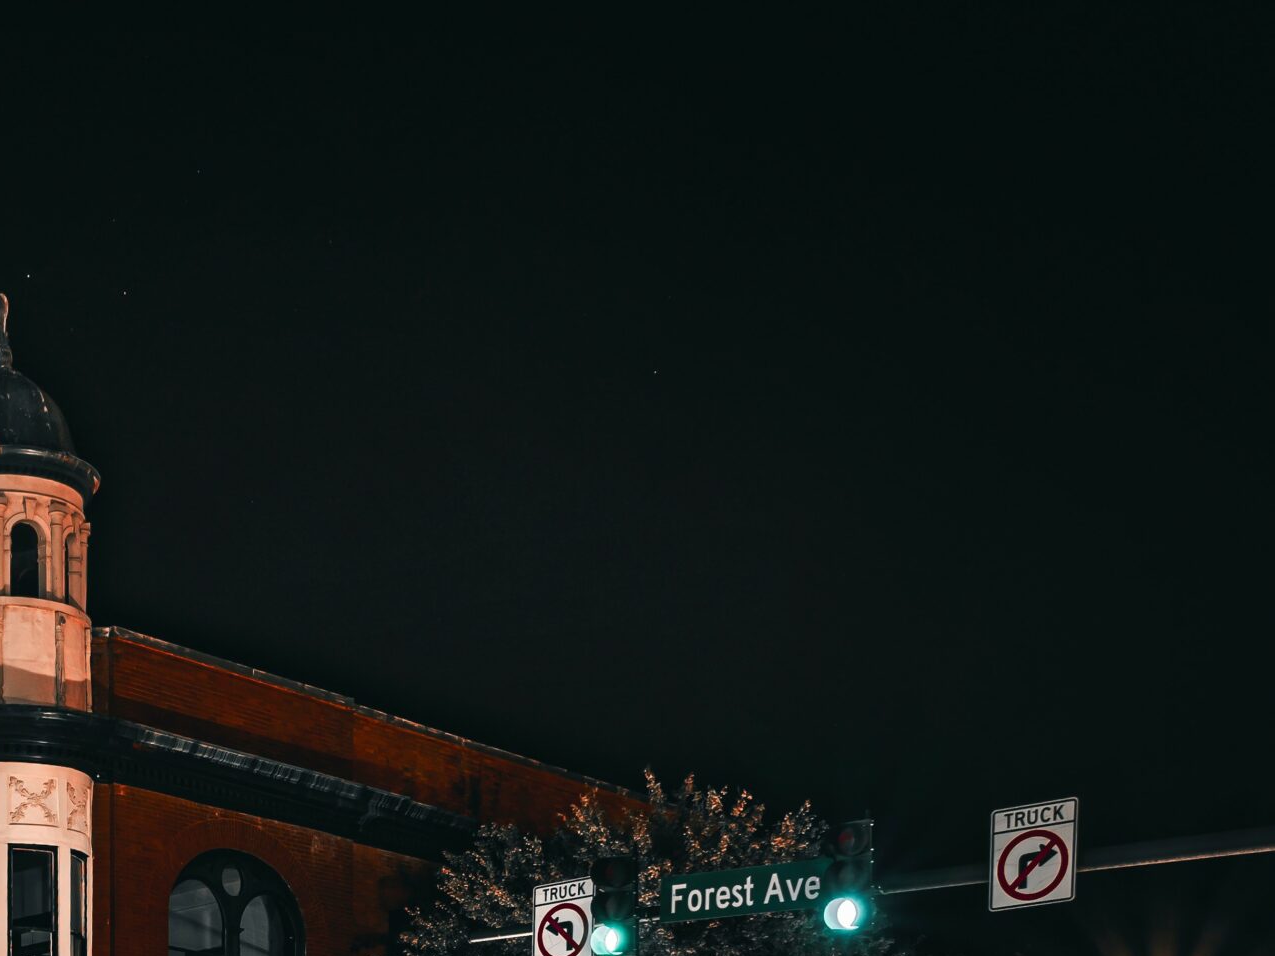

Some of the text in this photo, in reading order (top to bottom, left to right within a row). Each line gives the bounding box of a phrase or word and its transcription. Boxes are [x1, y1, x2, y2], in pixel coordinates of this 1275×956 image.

[1004, 804, 1065, 829] TRUCK
[542, 881, 586, 902] TRUCK
[670, 872, 821, 914] Forest Ave
